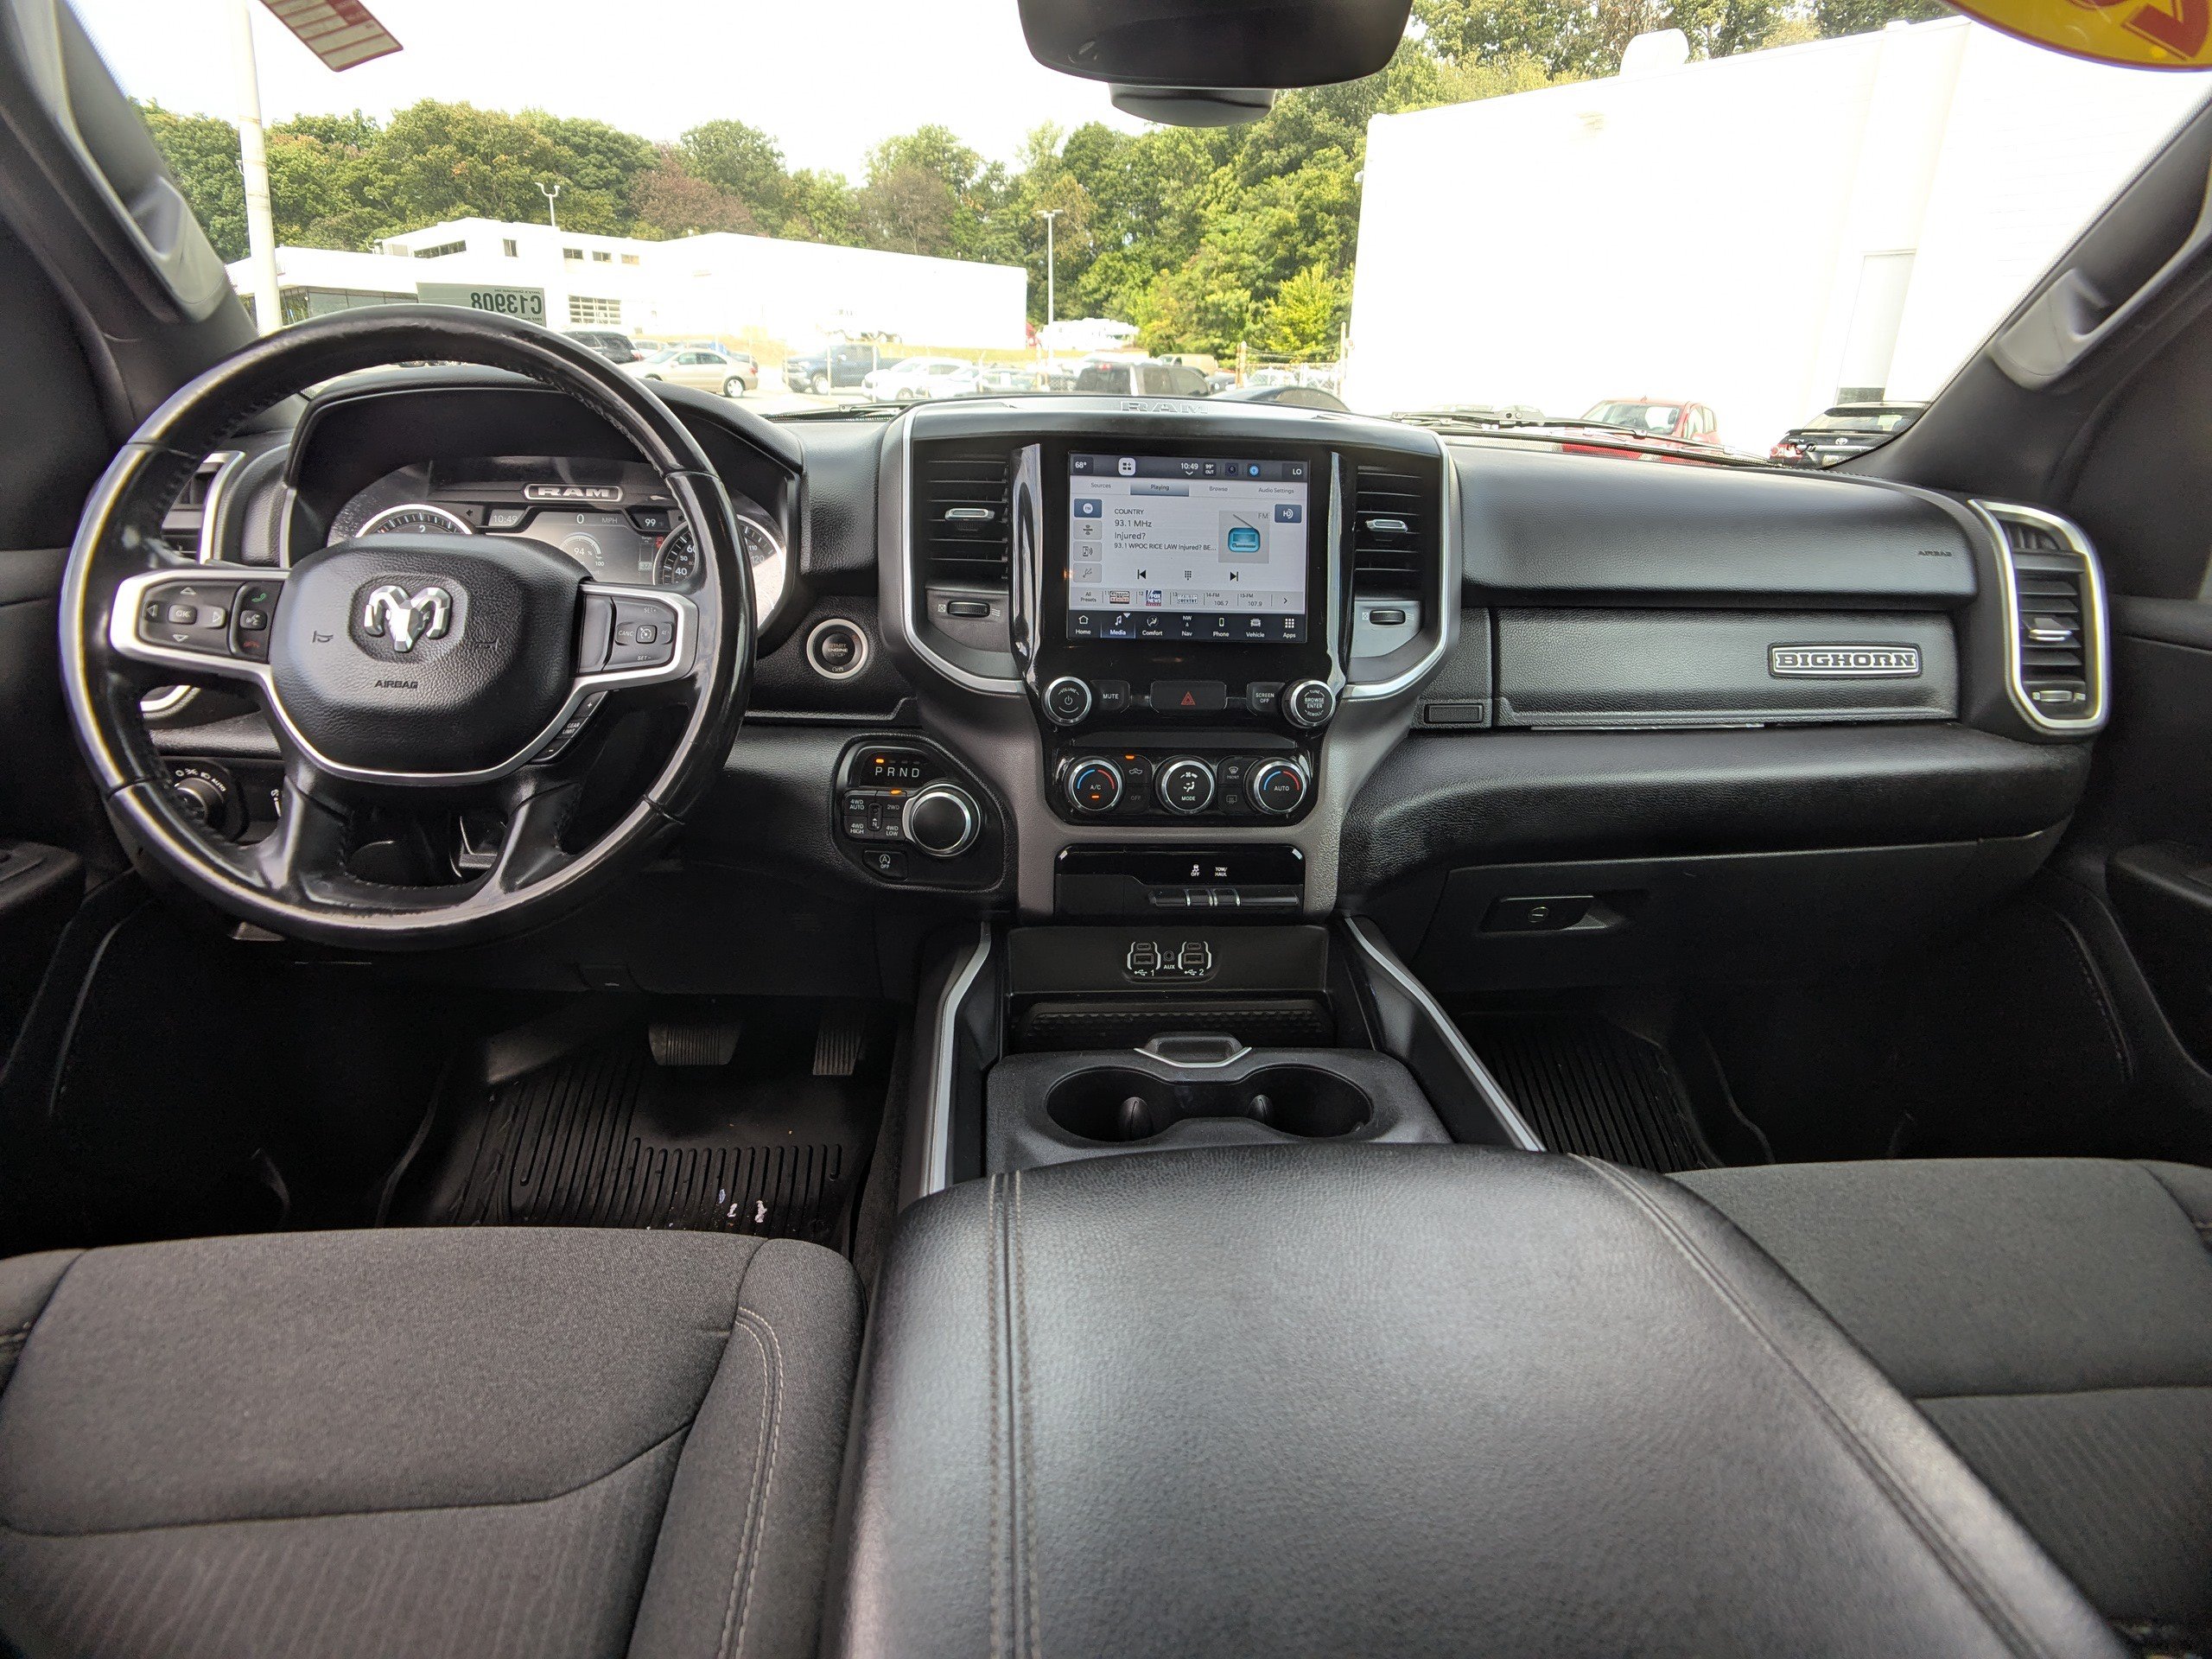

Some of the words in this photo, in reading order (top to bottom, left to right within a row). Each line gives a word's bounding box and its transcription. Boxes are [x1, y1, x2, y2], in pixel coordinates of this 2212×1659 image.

[1121, 401, 1209, 414] RAM
[537, 487, 609, 498] RAM
[493, 515, 518, 524] 10:49
[576, 514, 585, 524] 0
[1115, 532, 1146, 541] Injured?
[574, 547, 585, 556] 94
[674, 567, 688, 576] 40
[175, 610, 191, 619] OK
[1776, 652, 1916, 668] BIGHORN
[374, 679, 418, 690] AIRBAG
[874, 766, 883, 776] P
[887, 767, 895, 777] R
[899, 767, 908, 778] N
[912, 768, 920, 778] D
[211, 778, 227, 791] AUTO
